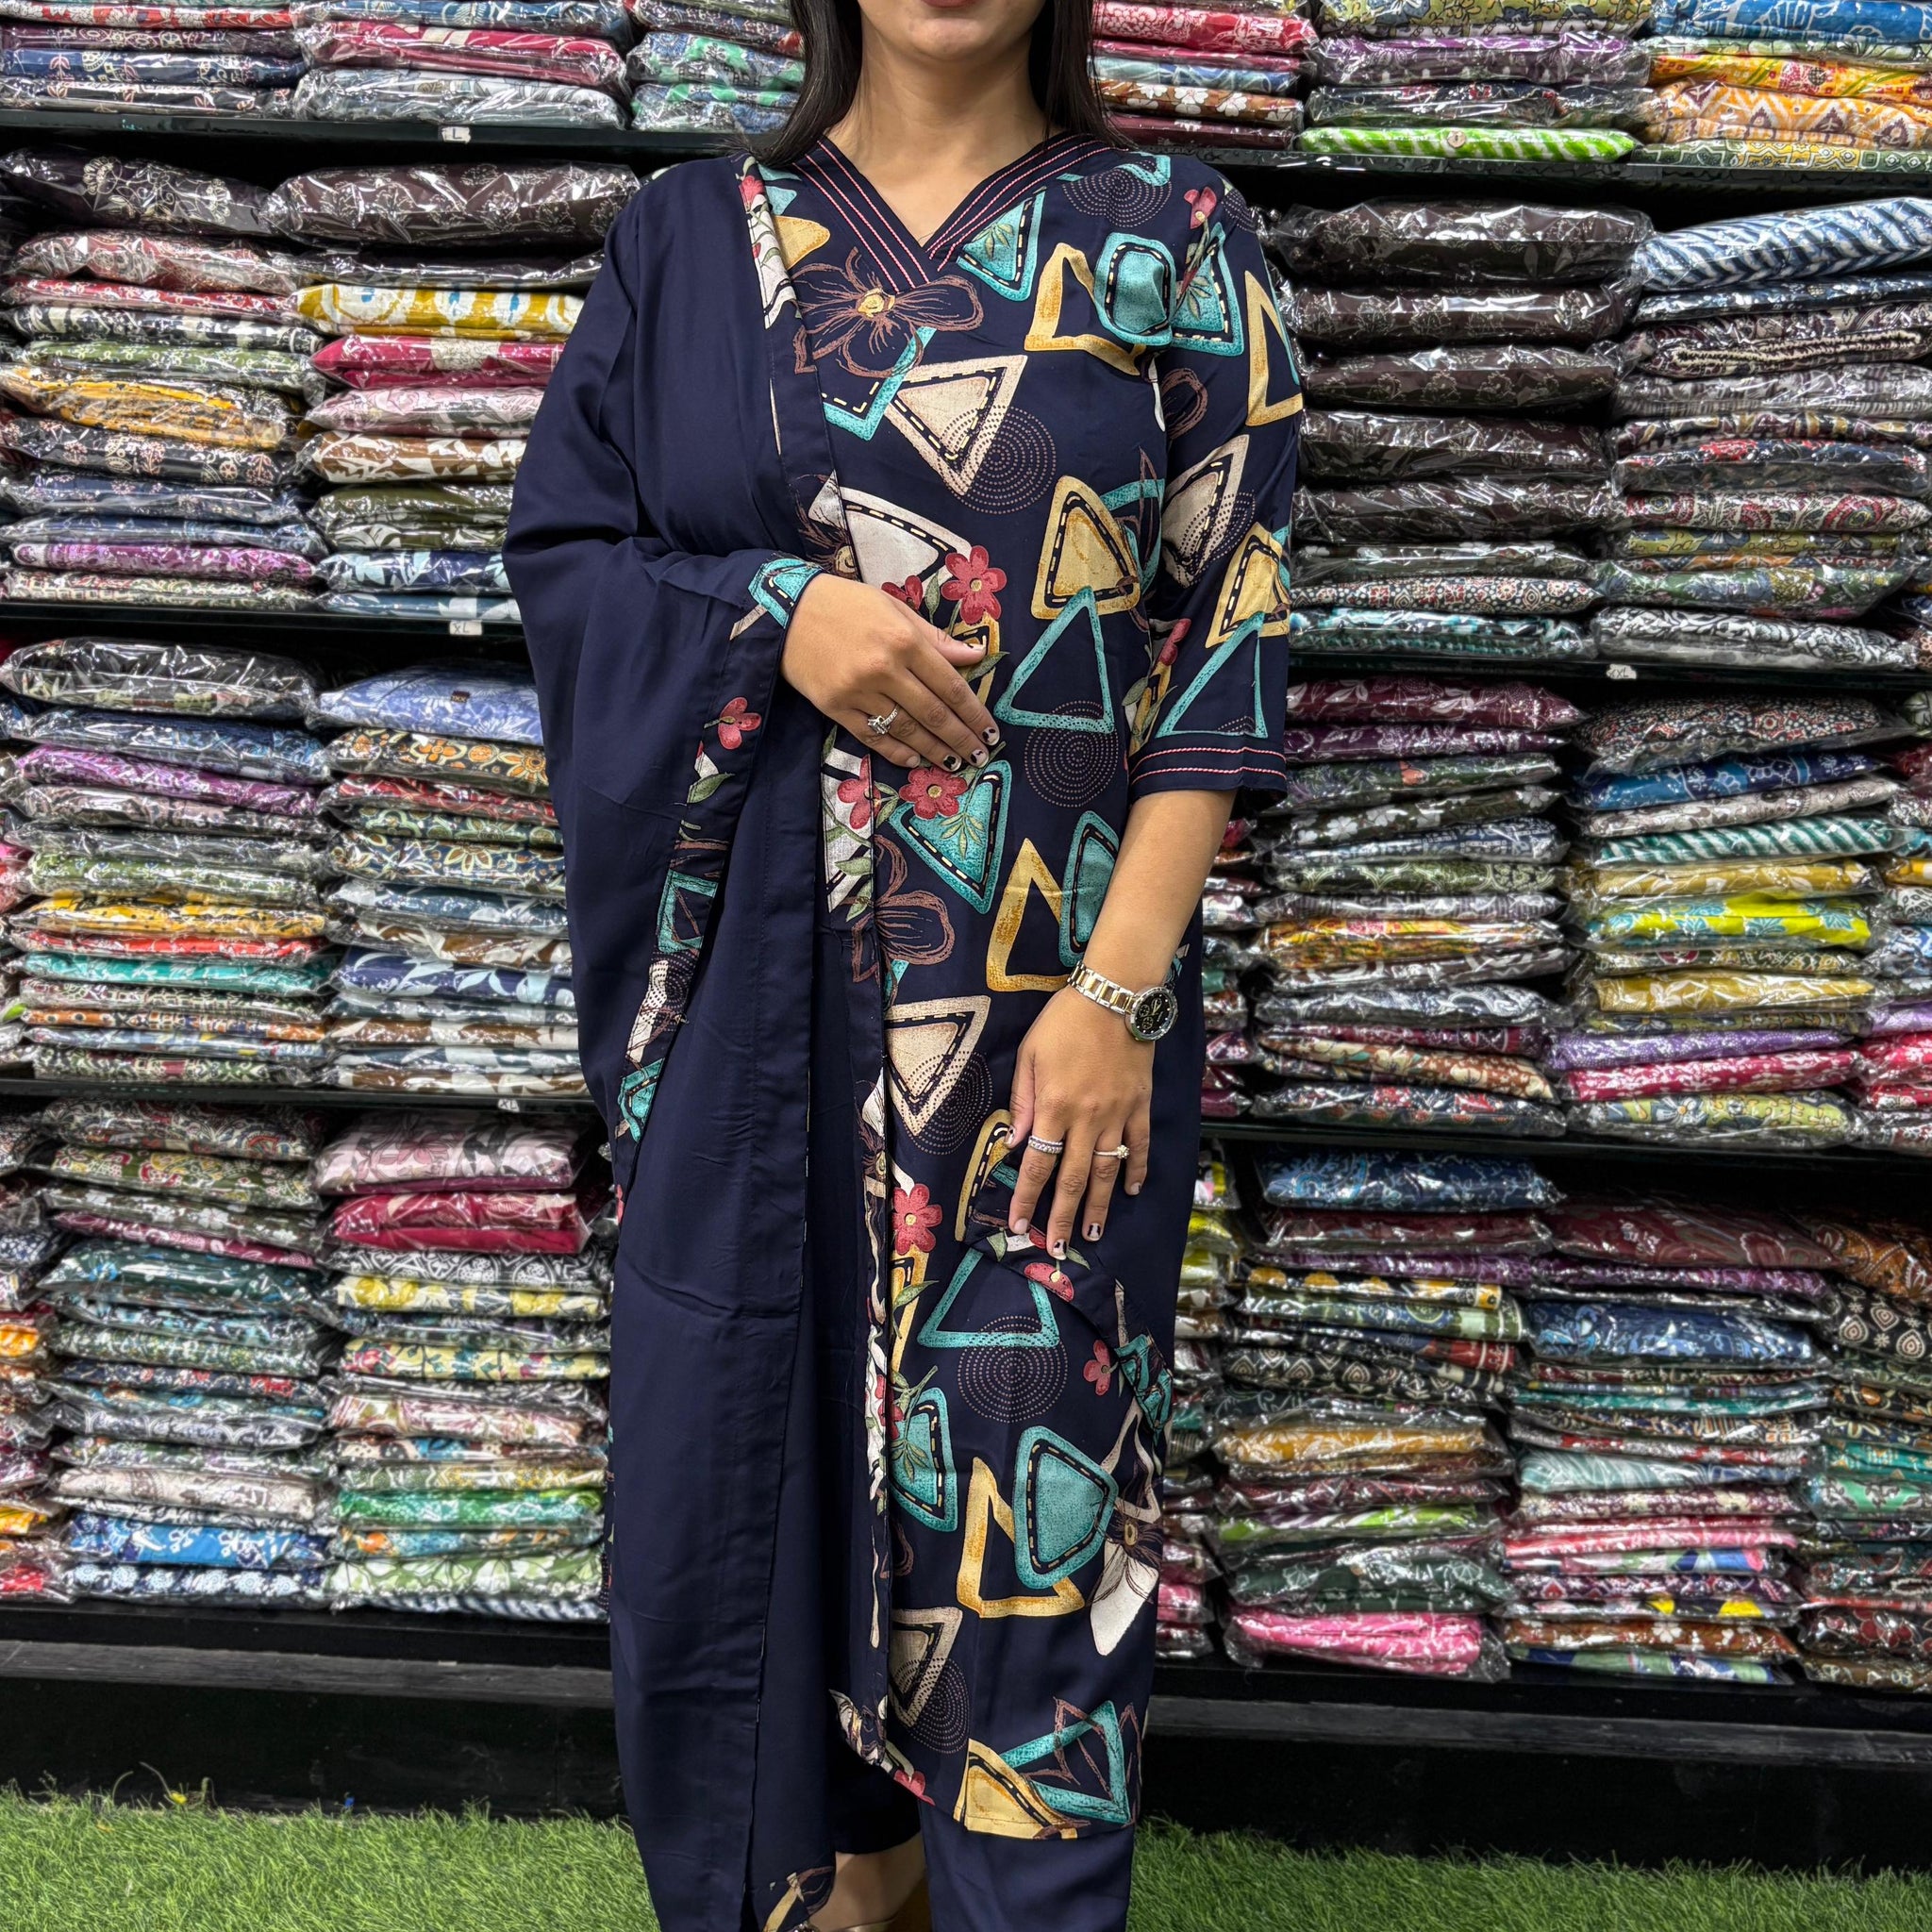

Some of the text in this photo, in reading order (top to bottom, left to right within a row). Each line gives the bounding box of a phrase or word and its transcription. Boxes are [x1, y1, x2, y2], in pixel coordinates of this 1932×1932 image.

[452, 127, 462, 140] L
[452, 622, 470, 634] XL
[500, 1098, 518, 1110] XL
